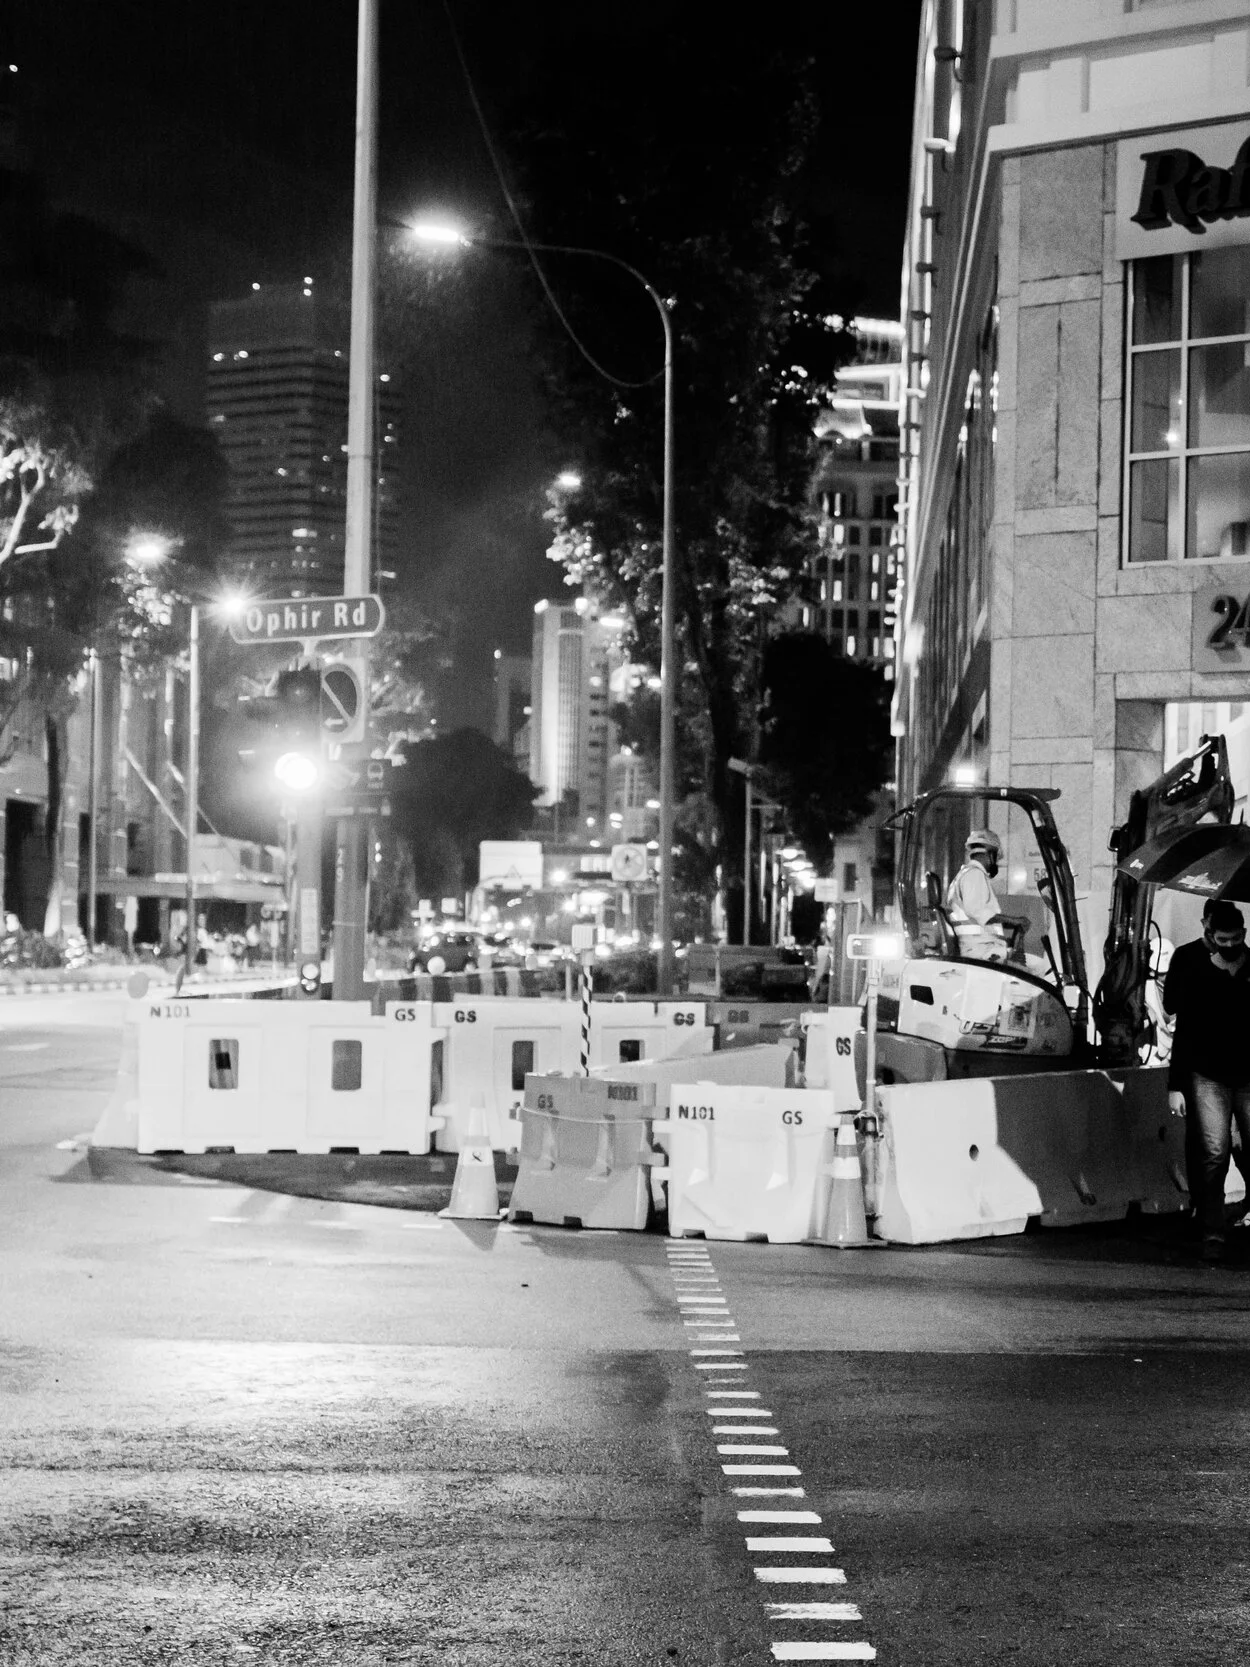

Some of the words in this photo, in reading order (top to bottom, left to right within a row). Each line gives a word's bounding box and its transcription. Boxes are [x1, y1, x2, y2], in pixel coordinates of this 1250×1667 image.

[246, 603, 321, 637] Ophir
[334, 601, 366, 627] Rd
[150, 1005, 191, 1019] N101
[395, 1008, 417, 1022] GS
[455, 1010, 477, 1023] GS
[673, 1012, 696, 1027] GS
[836, 1036, 852, 1057] GS
[678, 1104, 716, 1121] N101
[781, 1110, 804, 1126] GS
